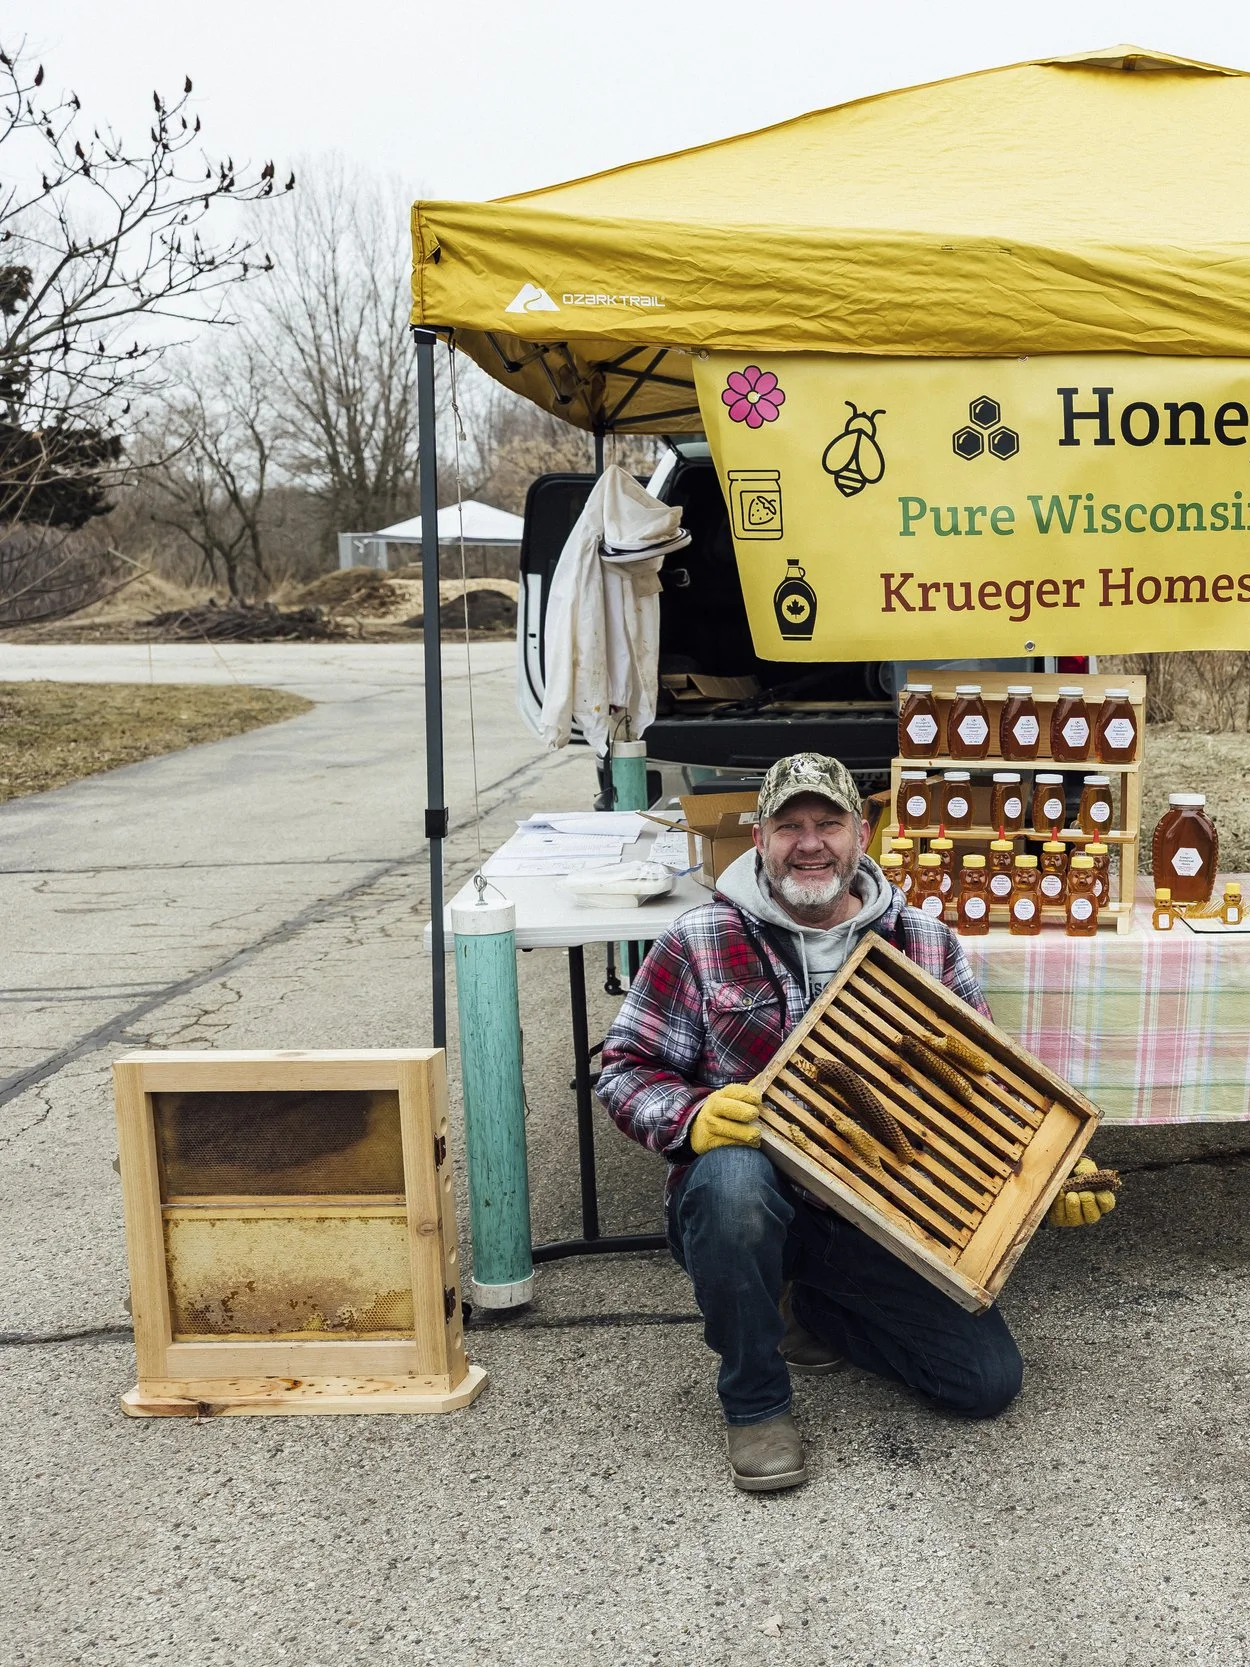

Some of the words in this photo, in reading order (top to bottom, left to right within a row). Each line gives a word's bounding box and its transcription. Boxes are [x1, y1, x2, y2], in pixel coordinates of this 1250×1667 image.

[562, 293, 617, 305] OZARK
[897, 495, 1015, 538] Pure
[880, 572, 1085, 623] Krueger
